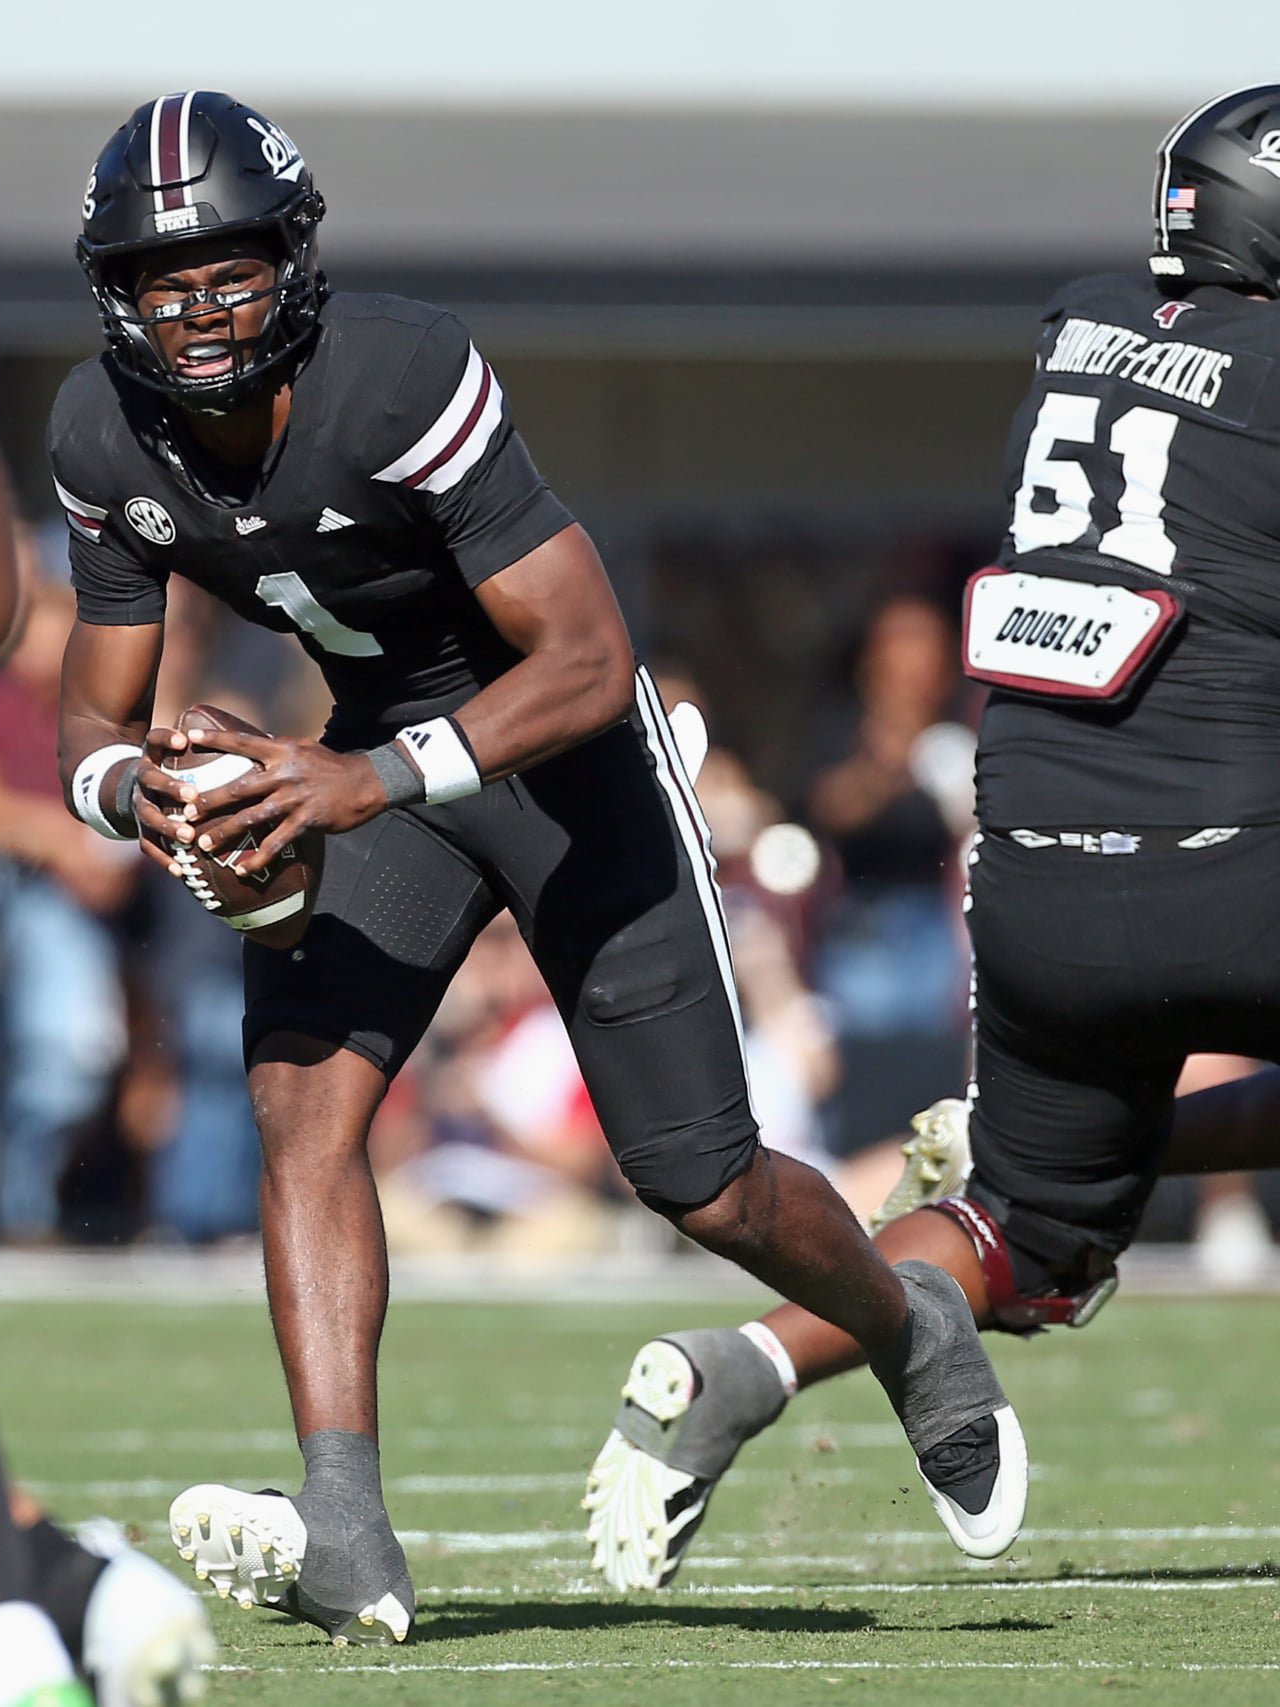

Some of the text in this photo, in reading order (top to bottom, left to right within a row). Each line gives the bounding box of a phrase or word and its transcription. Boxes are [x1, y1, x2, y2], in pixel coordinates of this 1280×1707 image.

[155, 213, 200, 233] STATE
[128, 501, 172, 541] SEC
[254, 571, 384, 658] 1
[995, 606, 1112, 657] DOUGLAS
